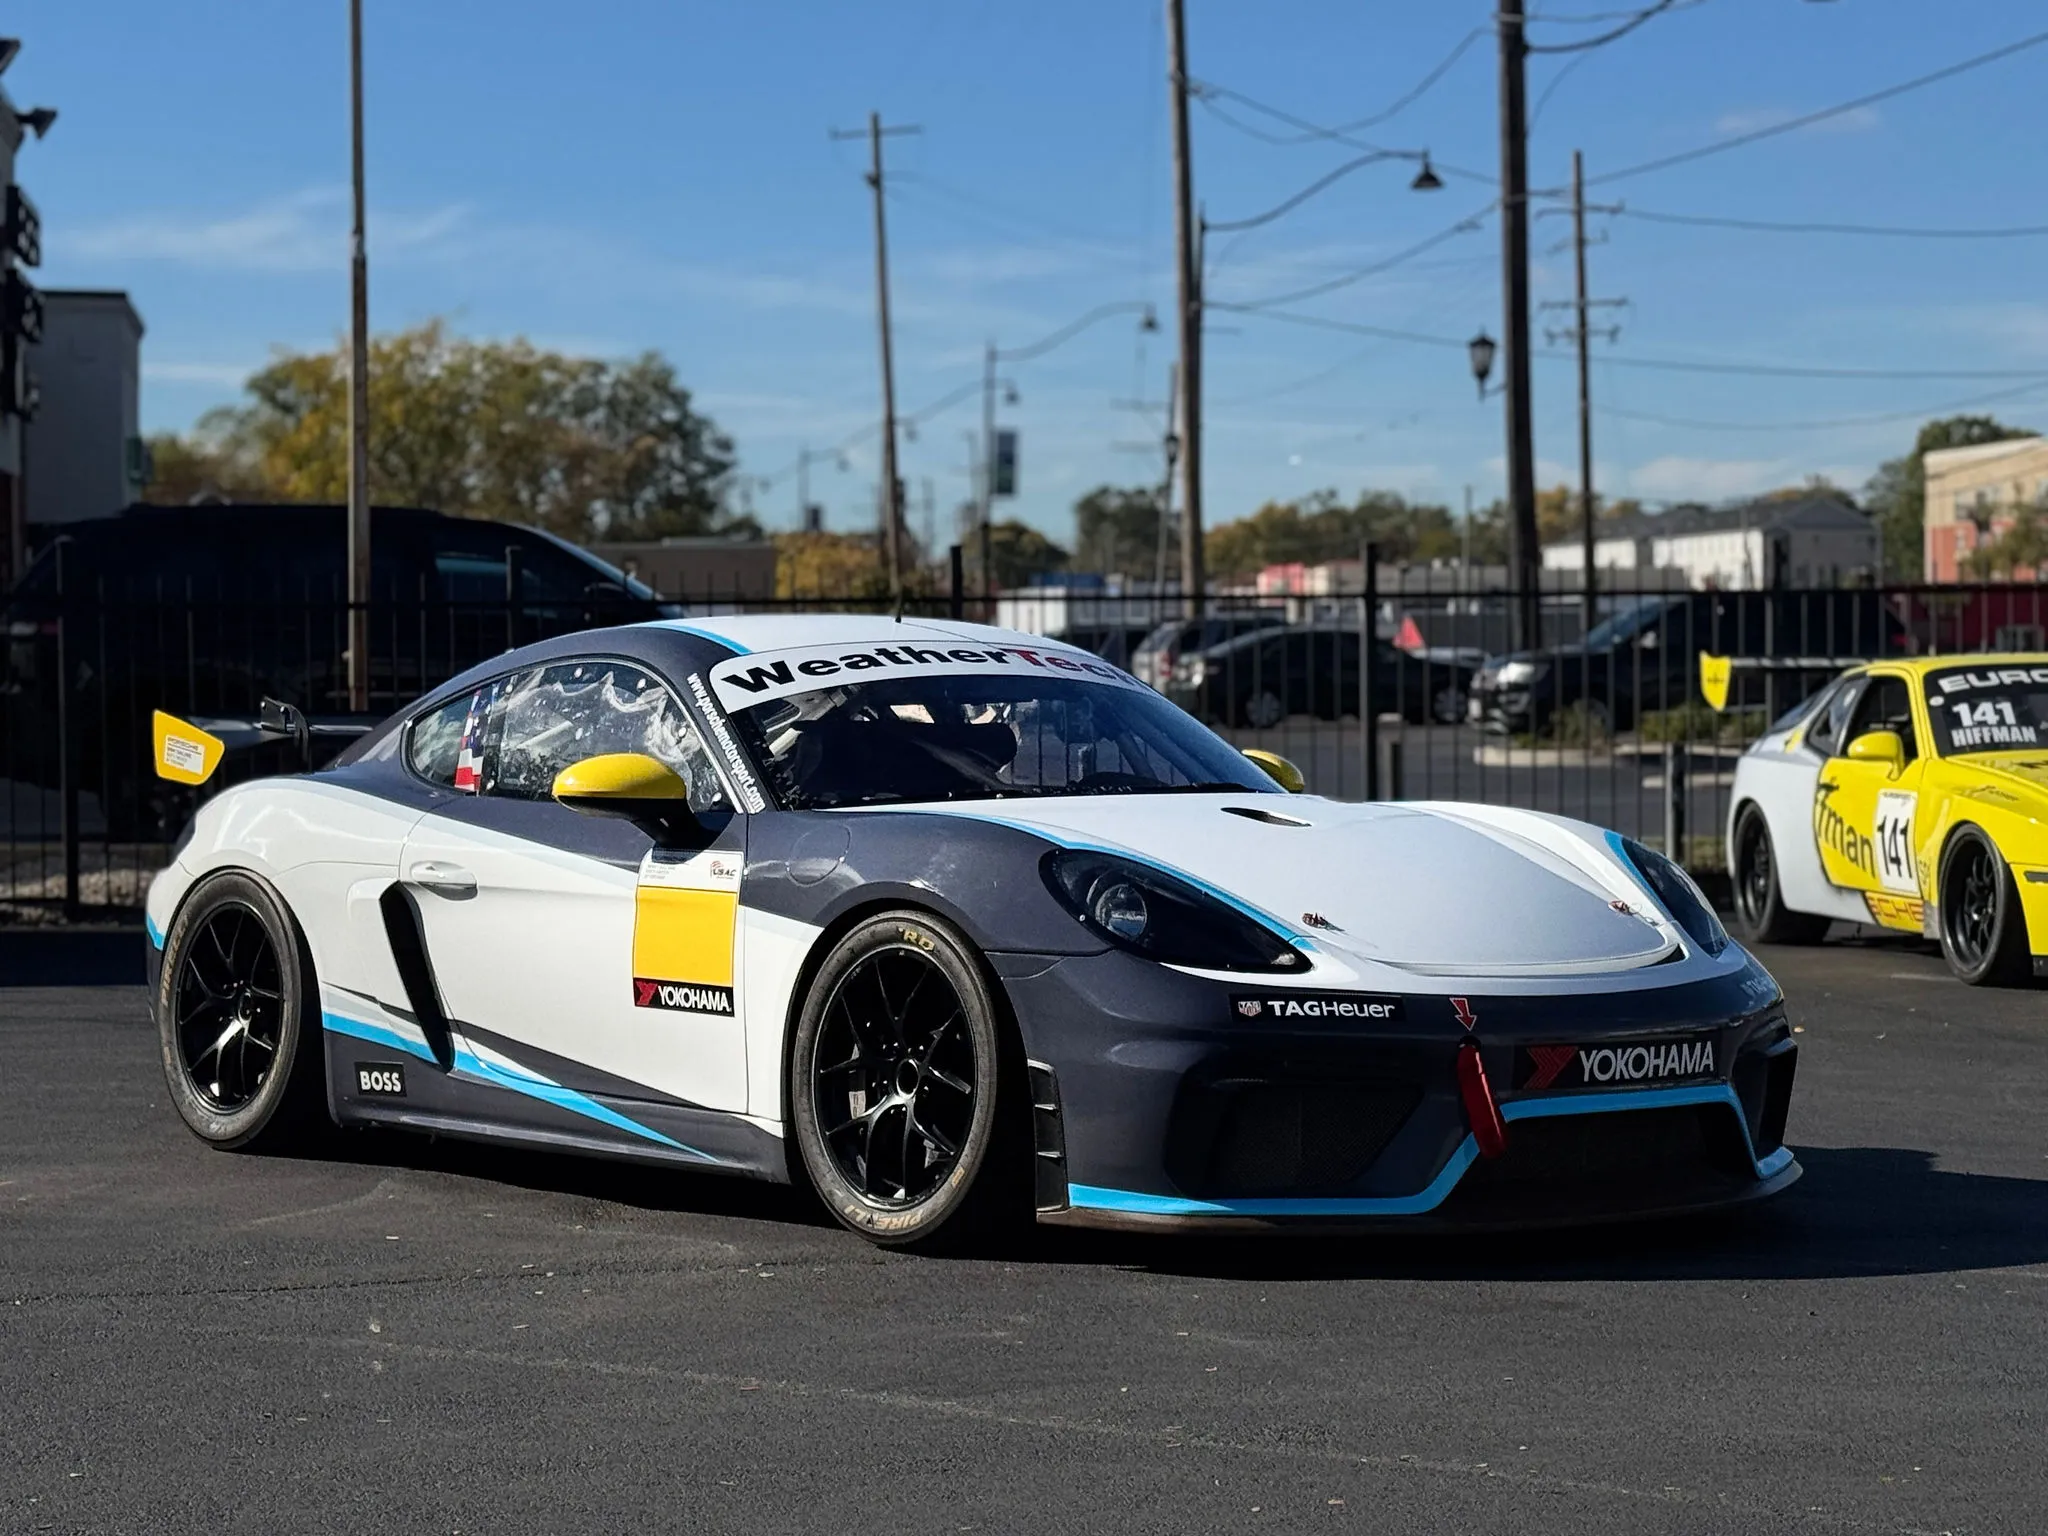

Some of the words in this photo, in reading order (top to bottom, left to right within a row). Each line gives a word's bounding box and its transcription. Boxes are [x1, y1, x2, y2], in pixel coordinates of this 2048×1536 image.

[1952, 702, 2016, 727] 141
[687, 673, 766, 813] www.porschemotorsport.com
[1951, 726, 2037, 747] HIFFMAN
[1877, 815, 1912, 879] 141
[658, 985, 730, 1012] YOKOHAMA
[1579, 1041, 1714, 1082] YOKOHAMA
[360, 1071, 401, 1092] BOSS
